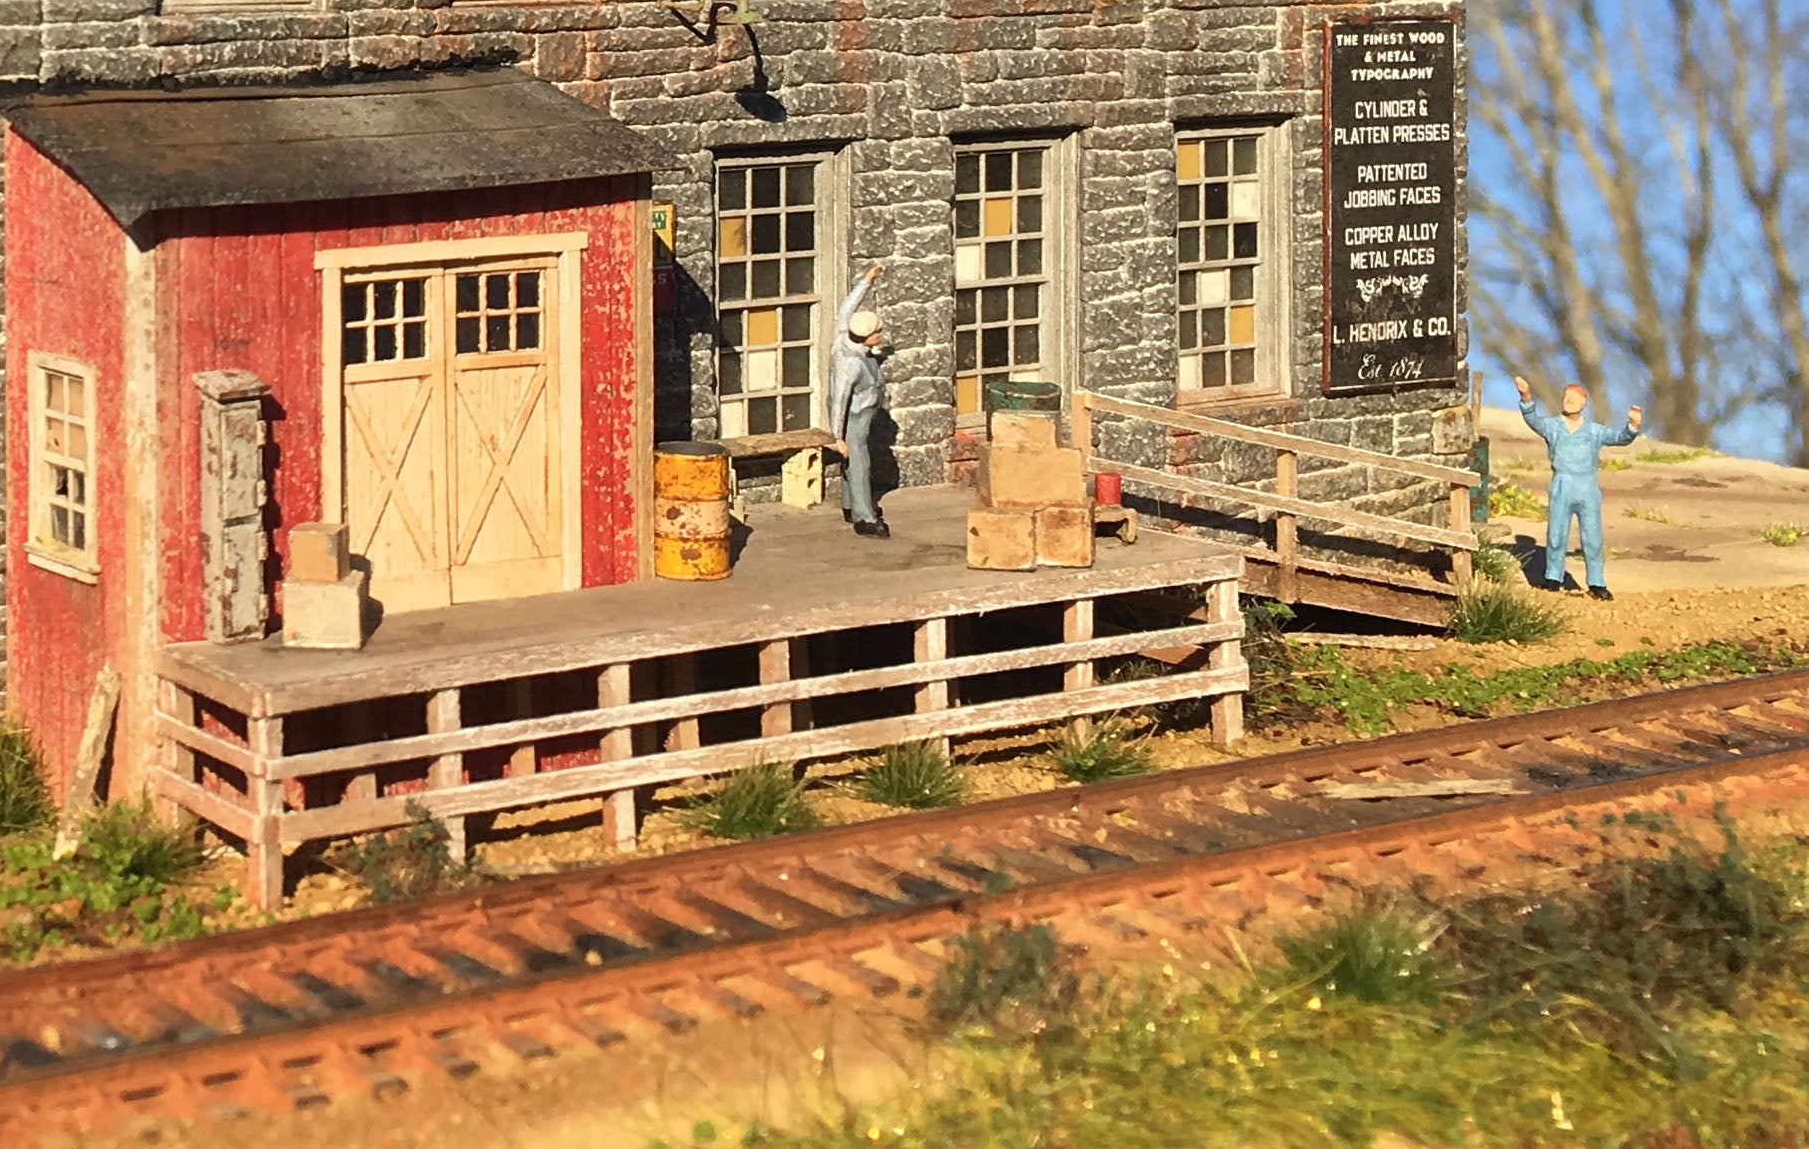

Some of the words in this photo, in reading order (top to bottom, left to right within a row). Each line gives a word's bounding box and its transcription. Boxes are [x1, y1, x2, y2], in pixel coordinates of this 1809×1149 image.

[1336, 34, 1358, 46] THE
[1363, 33, 1404, 45] FINEST
[1409, 32, 1445, 44] WOOD
[1364, 51, 1372, 62] &
[1377, 50, 1416, 62] METAL
[1351, 67, 1434, 81] TYPOGRAPHY
[1355, 100, 1416, 119] CYLINDER
[1419, 99, 1428, 116] &
[1334, 126, 1389, 145] PLATTEN
[1393, 124, 1450, 142] PRESSES
[1358, 162, 1427, 183] PATTENTED
[1344, 189, 1396, 208] JOBBING
[1400, 187, 1440, 205] FACES
[1345, 225, 1394, 245] COPPER
[1398, 223, 1438, 241] ALLOY
[1350, 250, 1390, 270] METAL
[1394, 248, 1435, 266] FACES
[1333, 325, 1345, 344] L.
[1350, 320, 1407, 343] HENDRIX
[1413, 318, 1423, 337] &
[1428, 317, 1451, 336] CO.
[1389, 357, 1424, 379] 1874
